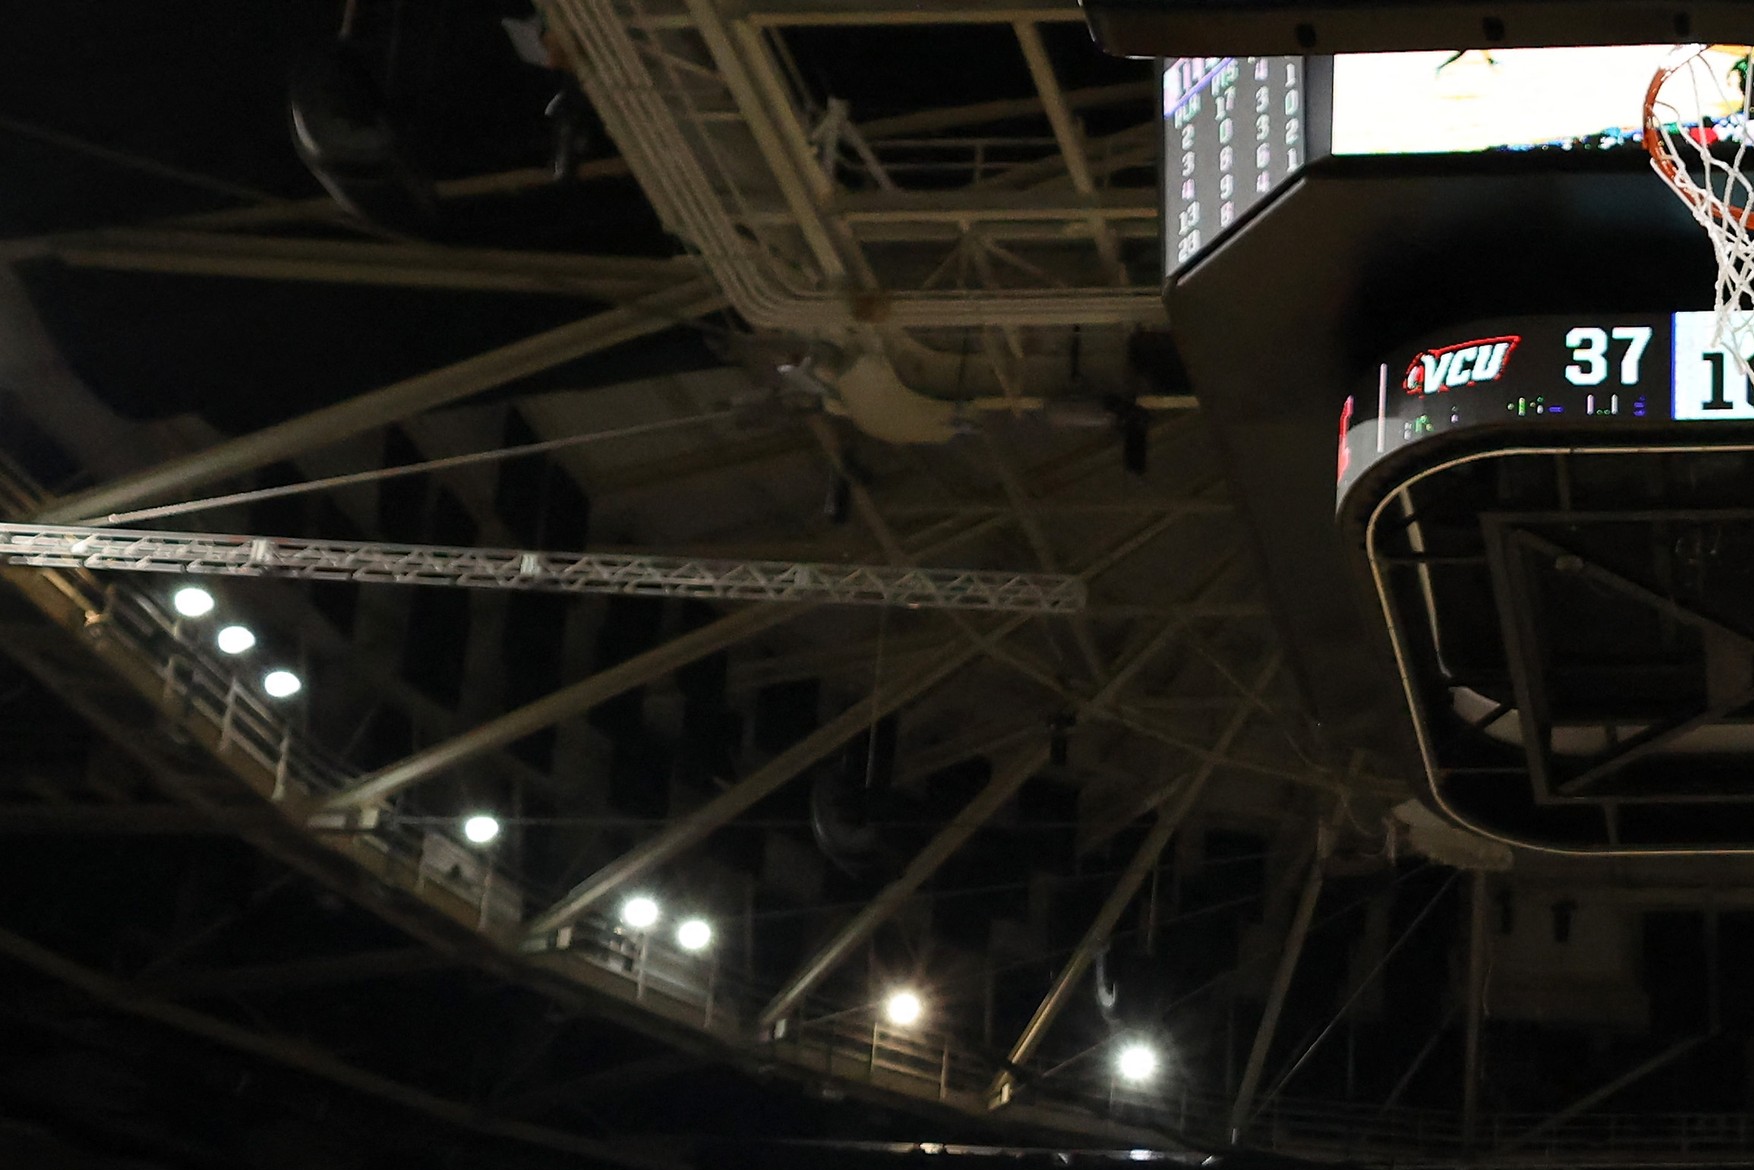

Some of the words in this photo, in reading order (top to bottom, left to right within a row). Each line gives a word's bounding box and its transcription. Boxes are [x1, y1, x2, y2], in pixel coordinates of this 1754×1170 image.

[1181, 123, 1195, 150] 2
[1182, 151, 1195, 178] 3
[1256, 86, 1269, 113] 3
[1285, 63, 1296, 88] 1
[1256, 114, 1270, 141] 3
[1285, 89, 1299, 116] 0
[1178, 201, 1200, 236] 13
[1285, 118, 1299, 145] 2
[1286, 148, 1298, 173] 1
[1420, 341, 1511, 395] VCU
[1564, 326, 1653, 386] 37
